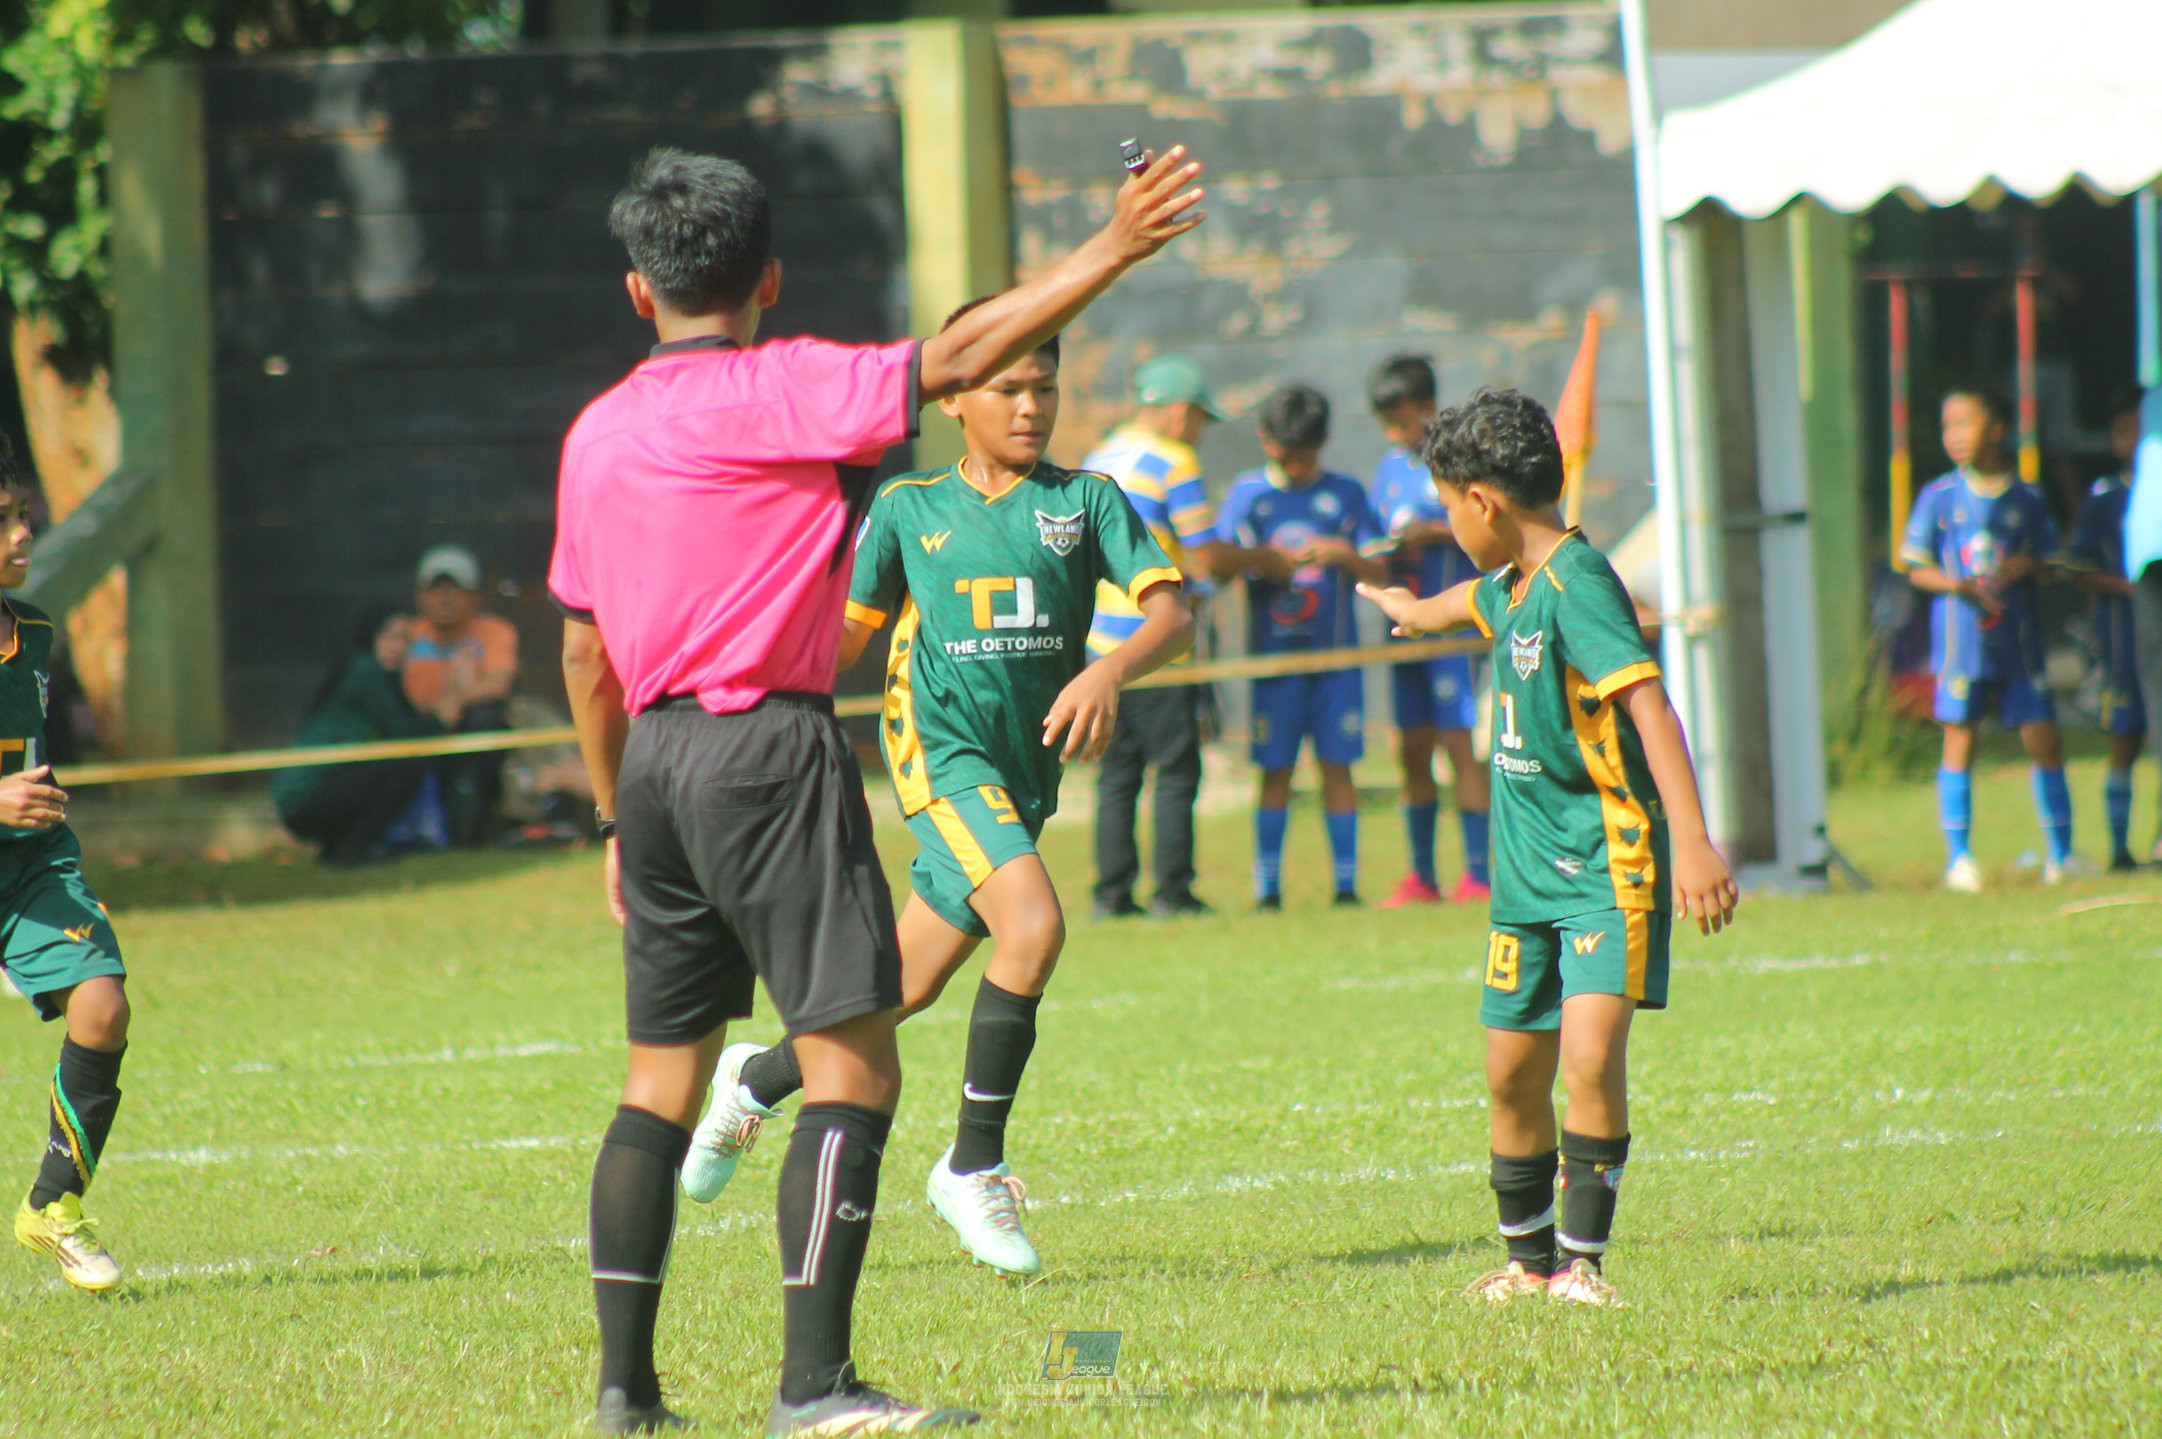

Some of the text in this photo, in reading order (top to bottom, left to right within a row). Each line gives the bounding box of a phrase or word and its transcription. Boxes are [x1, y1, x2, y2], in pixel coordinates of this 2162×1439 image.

[943, 636, 1064, 656] THE OETOMOS
[1485, 929, 1520, 992] 19
